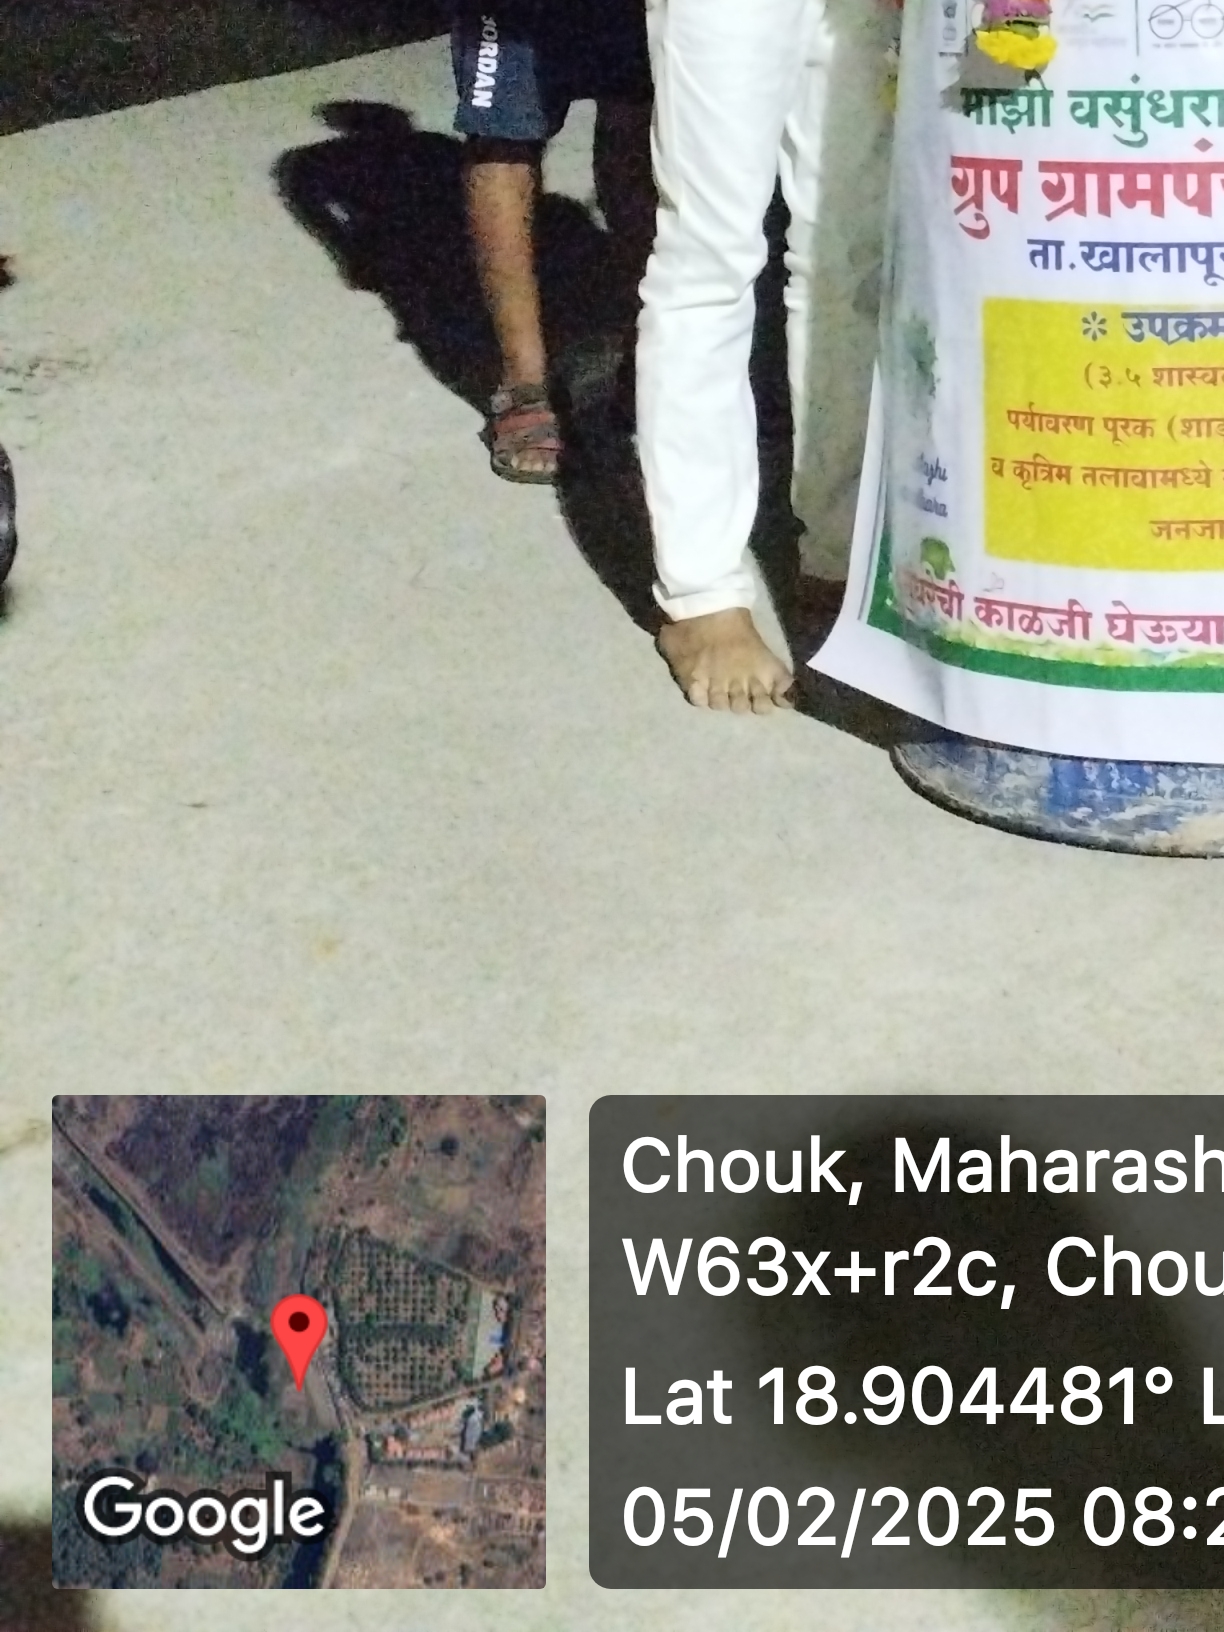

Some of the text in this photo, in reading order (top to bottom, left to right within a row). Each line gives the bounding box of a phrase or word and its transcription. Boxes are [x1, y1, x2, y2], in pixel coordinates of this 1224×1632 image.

[960, 69, 1053, 133] माझी
[950, 155, 1023, 240] ग्रुप
[1006, 401, 1095, 437] पर्यावरण
[1103, 417, 1156, 447] पूरक
[991, 456, 1005, 477] व
[1012, 453, 1073, 490] कृत्रिम
[1081, 459, 1212, 489] तलावामध्ये
[973, 598, 1093, 642] काळजी
